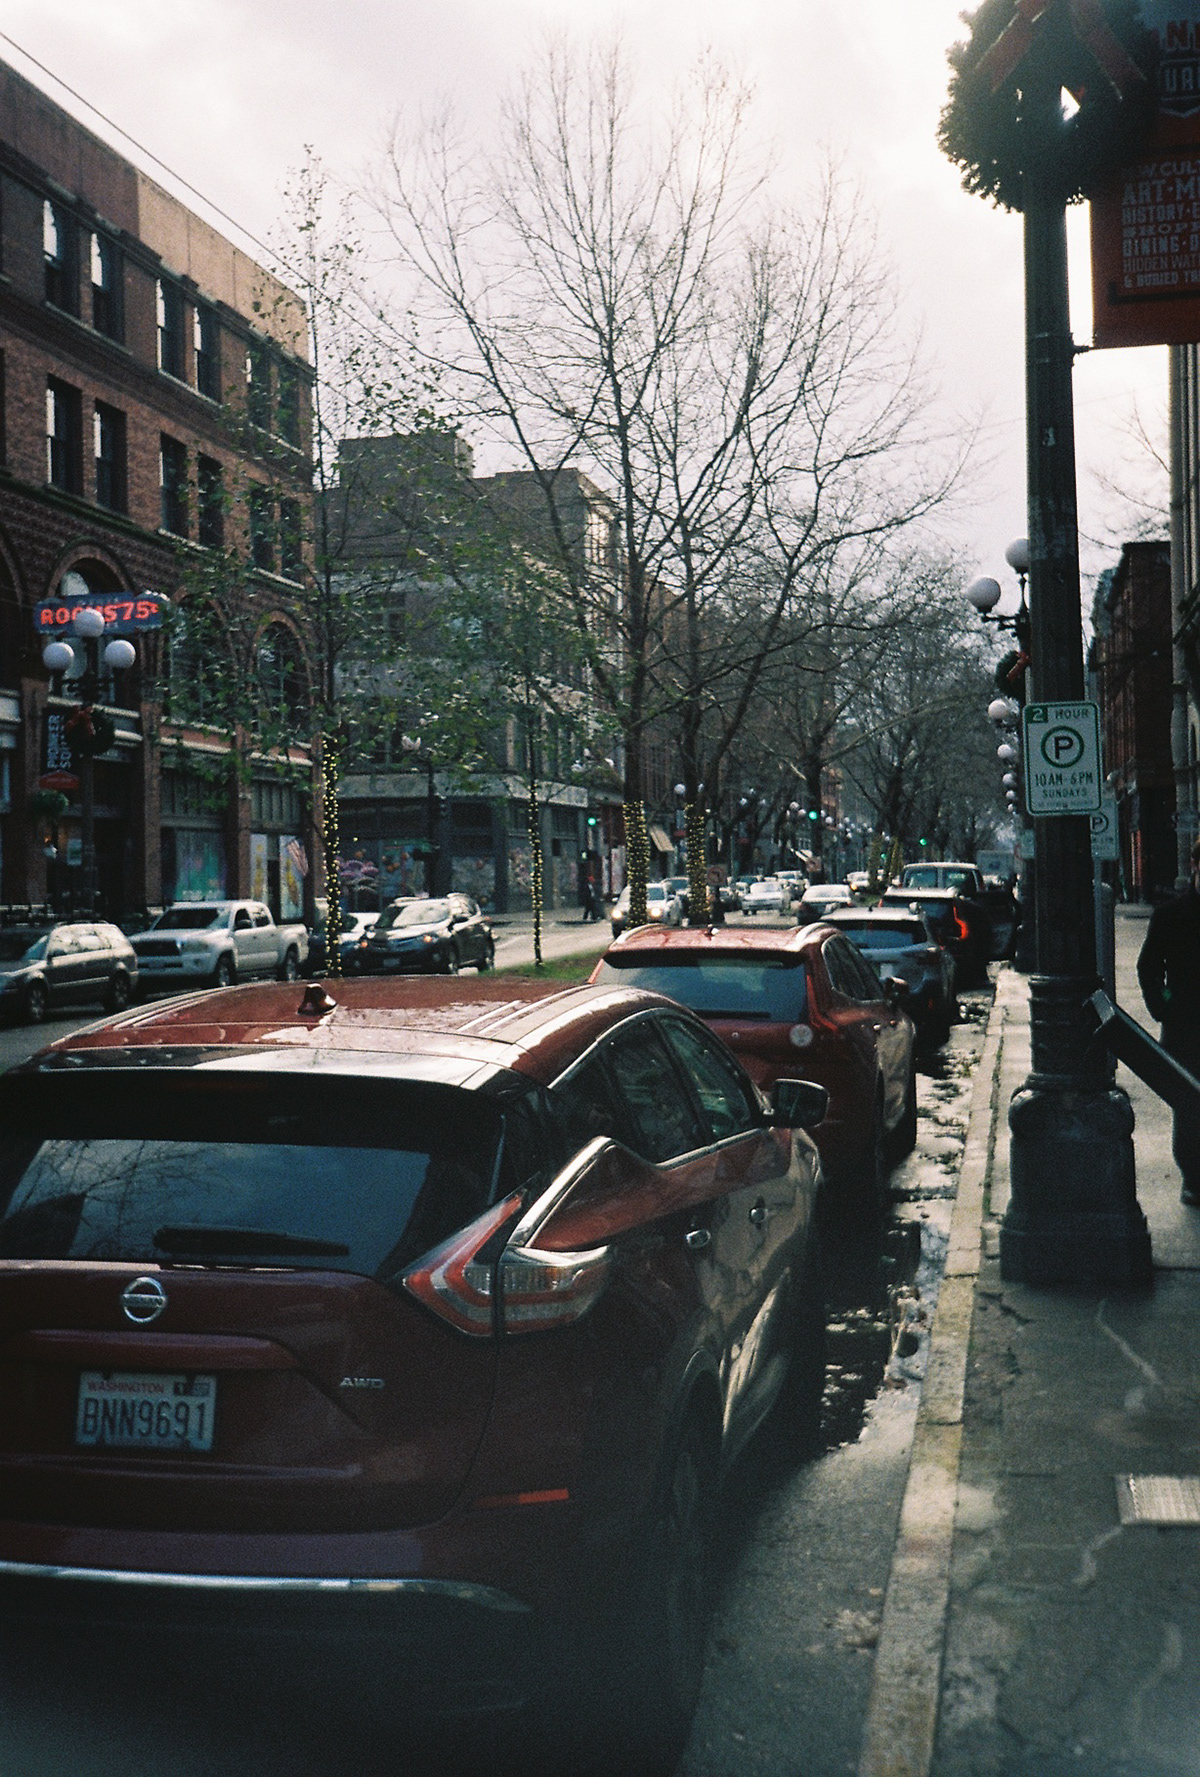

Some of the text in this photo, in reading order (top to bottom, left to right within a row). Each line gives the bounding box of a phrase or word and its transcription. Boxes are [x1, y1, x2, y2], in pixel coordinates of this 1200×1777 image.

[1122, 179, 1167, 206] ART
[1122, 203, 1184, 225] HISTORY
[1123, 234, 1180, 257] DINING
[1123, 254, 1168, 274] HIDDEN
[1032, 707, 1089, 721] 2 HOUR
[1042, 787, 1088, 799] SUNDAYS
[88, 1381, 165, 1393] WASHINGTON
[338, 1377, 386, 1391] AWD
[83, 1397, 206, 1442] BNN9691
